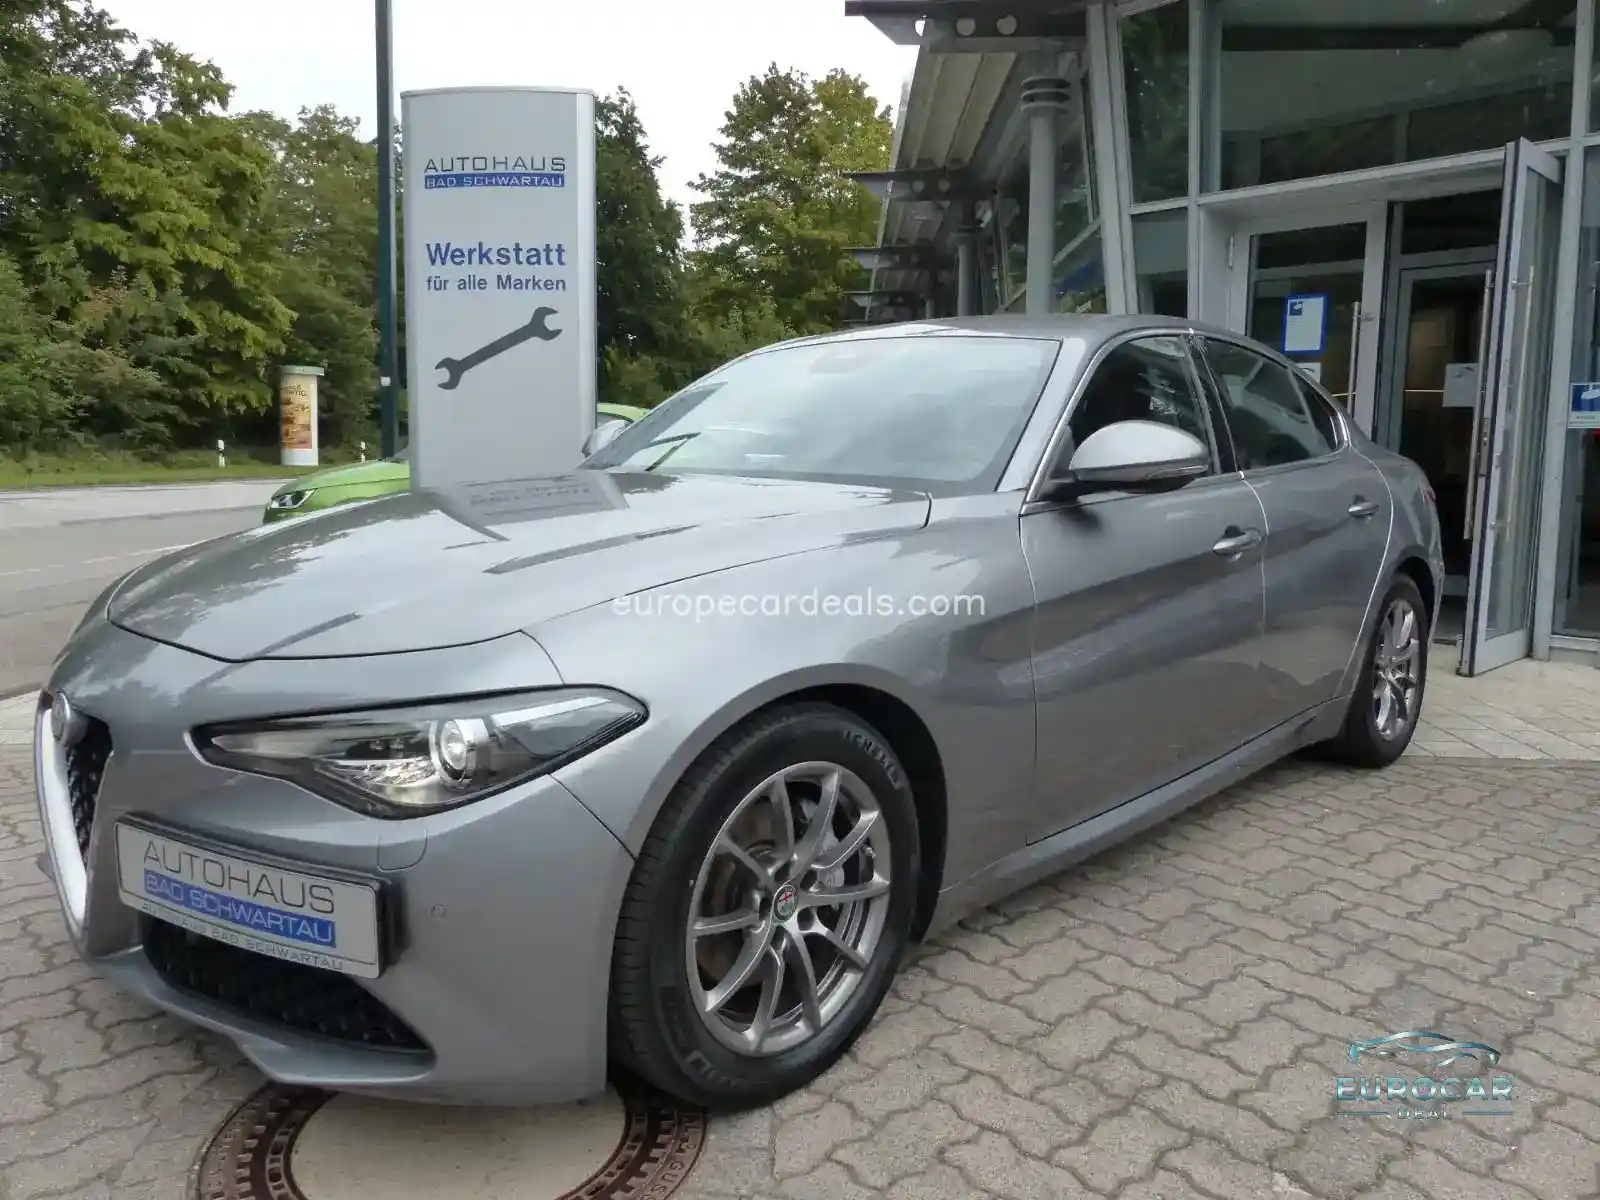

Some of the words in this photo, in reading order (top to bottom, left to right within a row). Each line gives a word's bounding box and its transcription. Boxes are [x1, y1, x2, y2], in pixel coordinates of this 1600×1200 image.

[425, 157, 565, 172] AUTOHAUS
[426, 177, 457, 188] BAD
[463, 176, 562, 187] SCHWARTAU
[426, 242, 566, 266] Werkstatt
[427, 275, 449, 292] für
[457, 274, 488, 290] alle
[497, 274, 566, 291] Marken
[143, 840, 334, 914] AUTOHAUS
[146, 873, 184, 901] BAD
[190, 889, 333, 943] SCHWARTAU
[246, 940, 343, 971] SCHWARTAU
